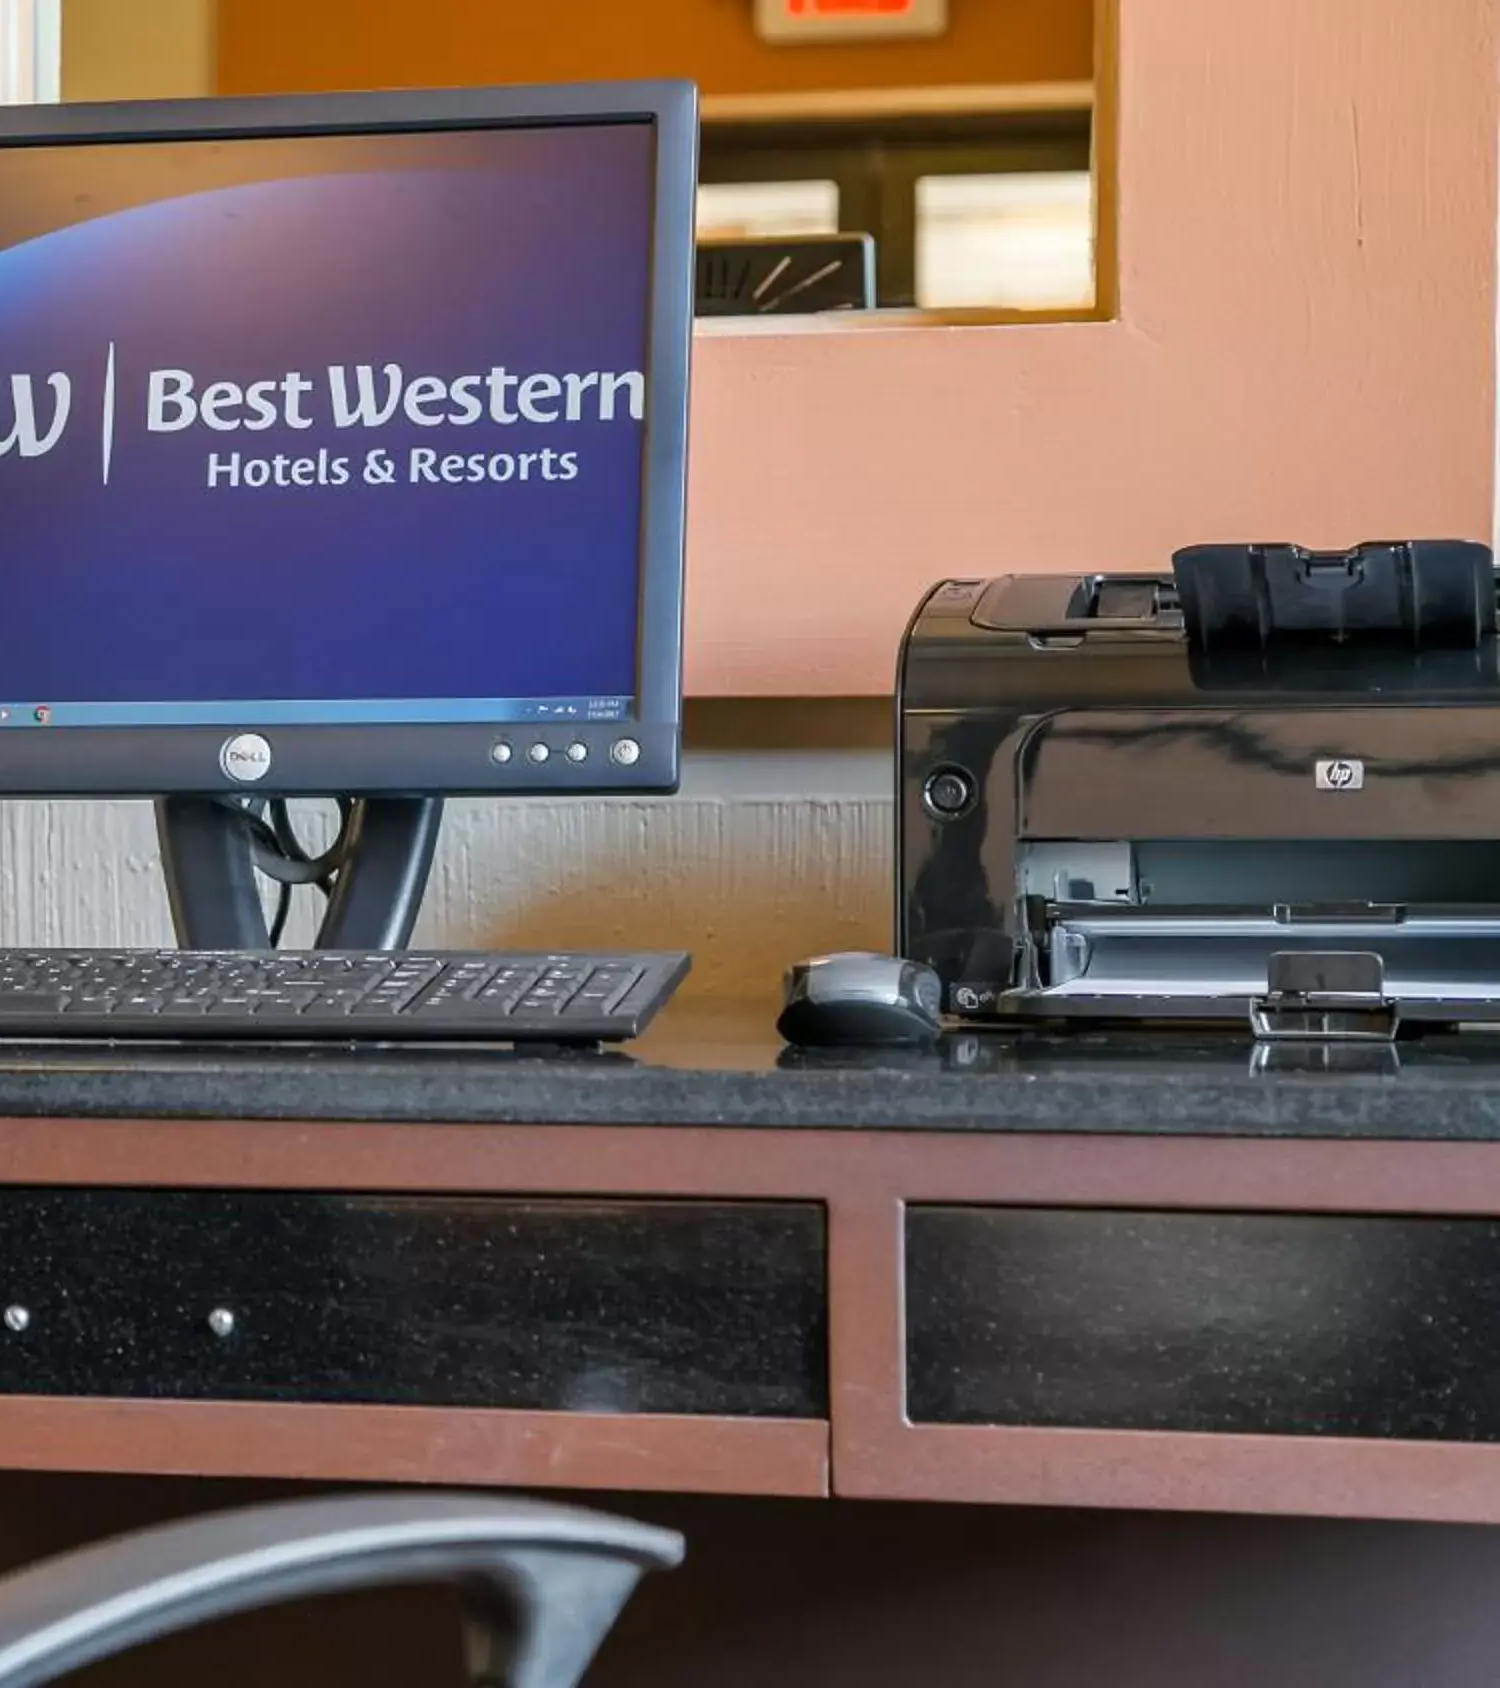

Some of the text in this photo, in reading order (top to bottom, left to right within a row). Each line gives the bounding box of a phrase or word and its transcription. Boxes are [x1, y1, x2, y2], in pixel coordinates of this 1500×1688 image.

[147, 364, 645, 431] Best Western
[207, 448, 578, 486] Hotels & Resorts
[229, 751, 267, 763] DELL
[1329, 761, 1351, 788] hp
